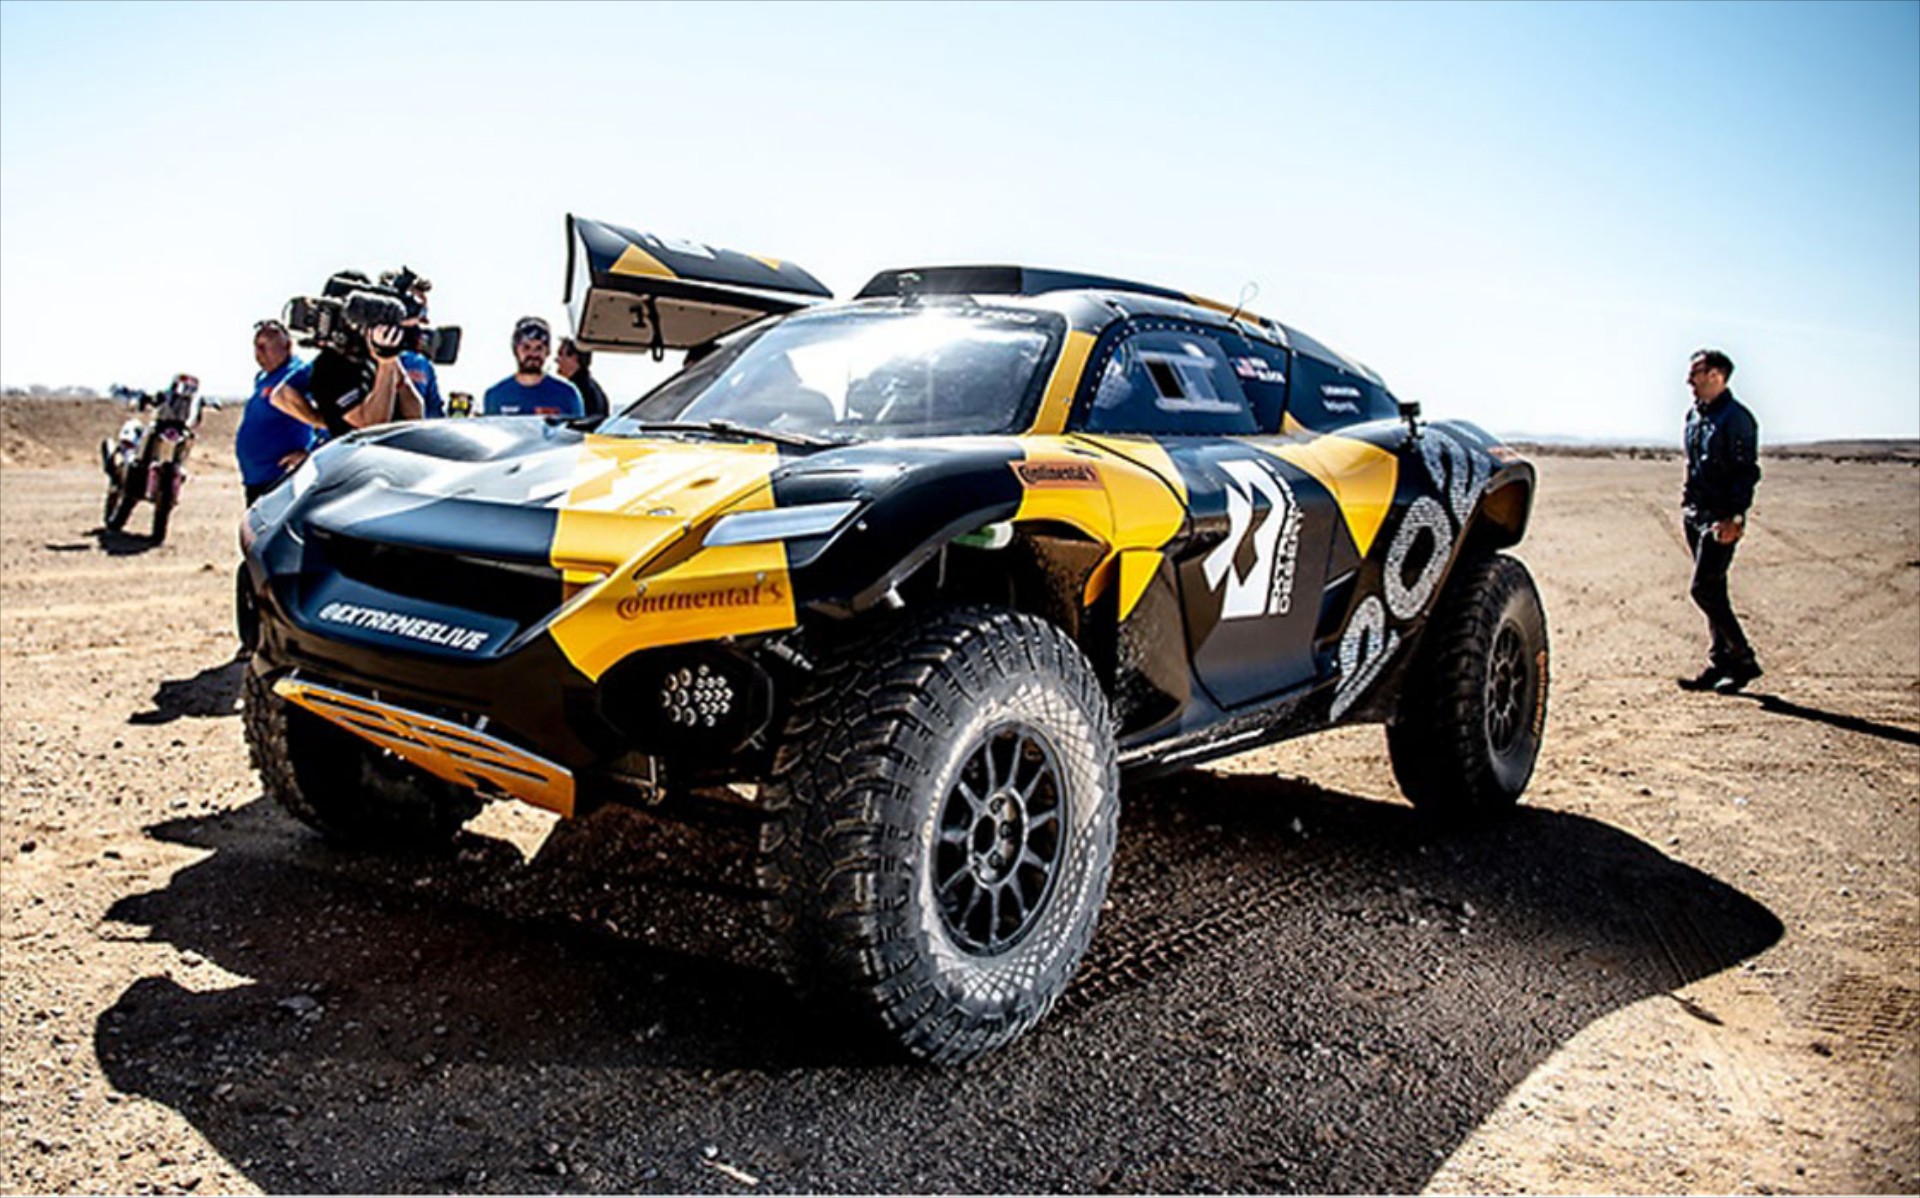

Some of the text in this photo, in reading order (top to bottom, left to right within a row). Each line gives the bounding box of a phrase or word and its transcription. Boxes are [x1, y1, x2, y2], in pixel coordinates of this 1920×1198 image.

[1018, 464, 1089, 485] Continental
[616, 580, 760, 620] Continental
[319, 602, 489, 651] @EXTREMEELIVE
